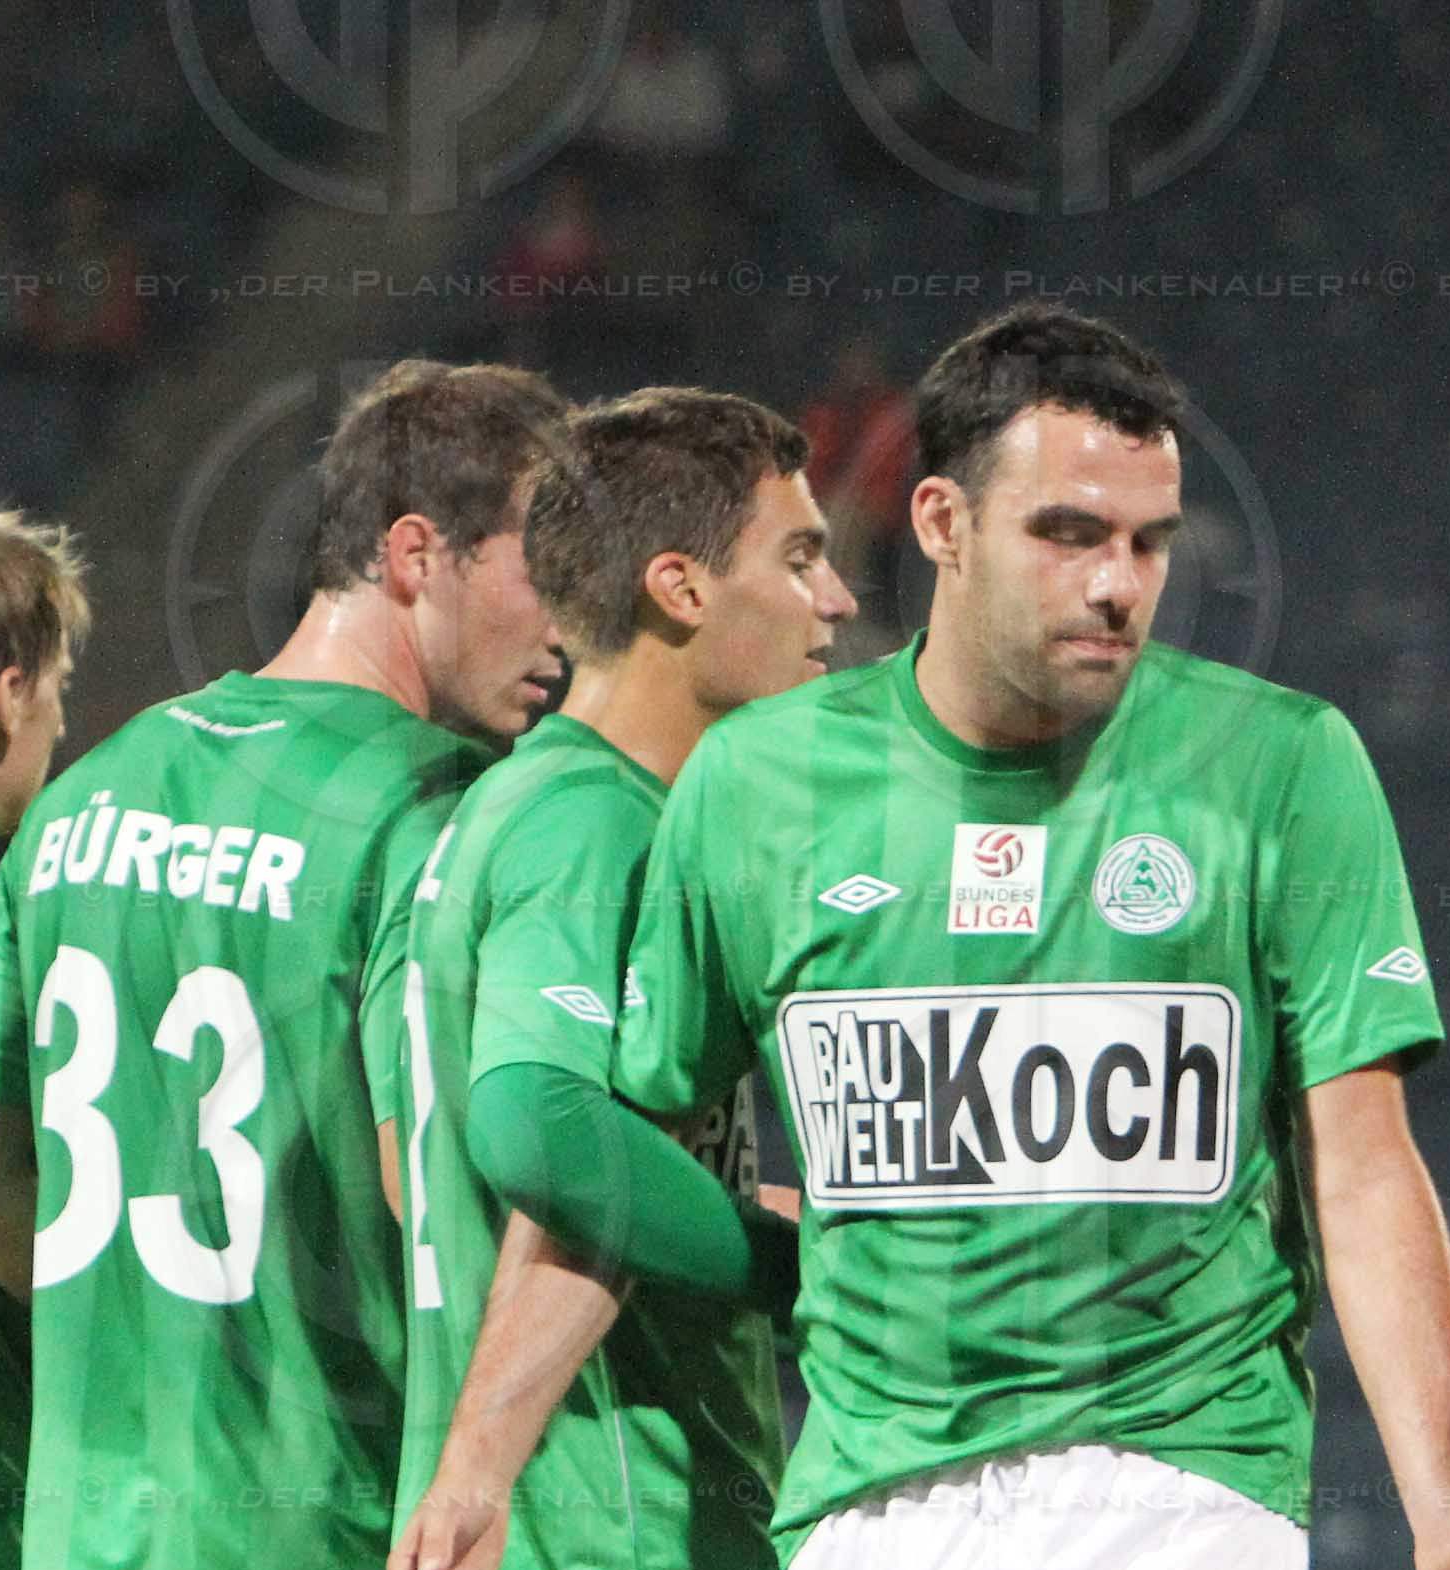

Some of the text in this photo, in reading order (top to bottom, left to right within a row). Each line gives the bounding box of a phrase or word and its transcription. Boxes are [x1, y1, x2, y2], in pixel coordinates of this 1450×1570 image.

[27, 790, 306, 921] BÜRGER
[955, 887, 1036, 902] BUNDES
[954, 904, 1033, 929] LIGA
[809, 1011, 904, 1101] BAU
[928, 1004, 1219, 1165] Koch
[32, 944, 266, 1305] 33
[810, 1101, 923, 1184] WELT
